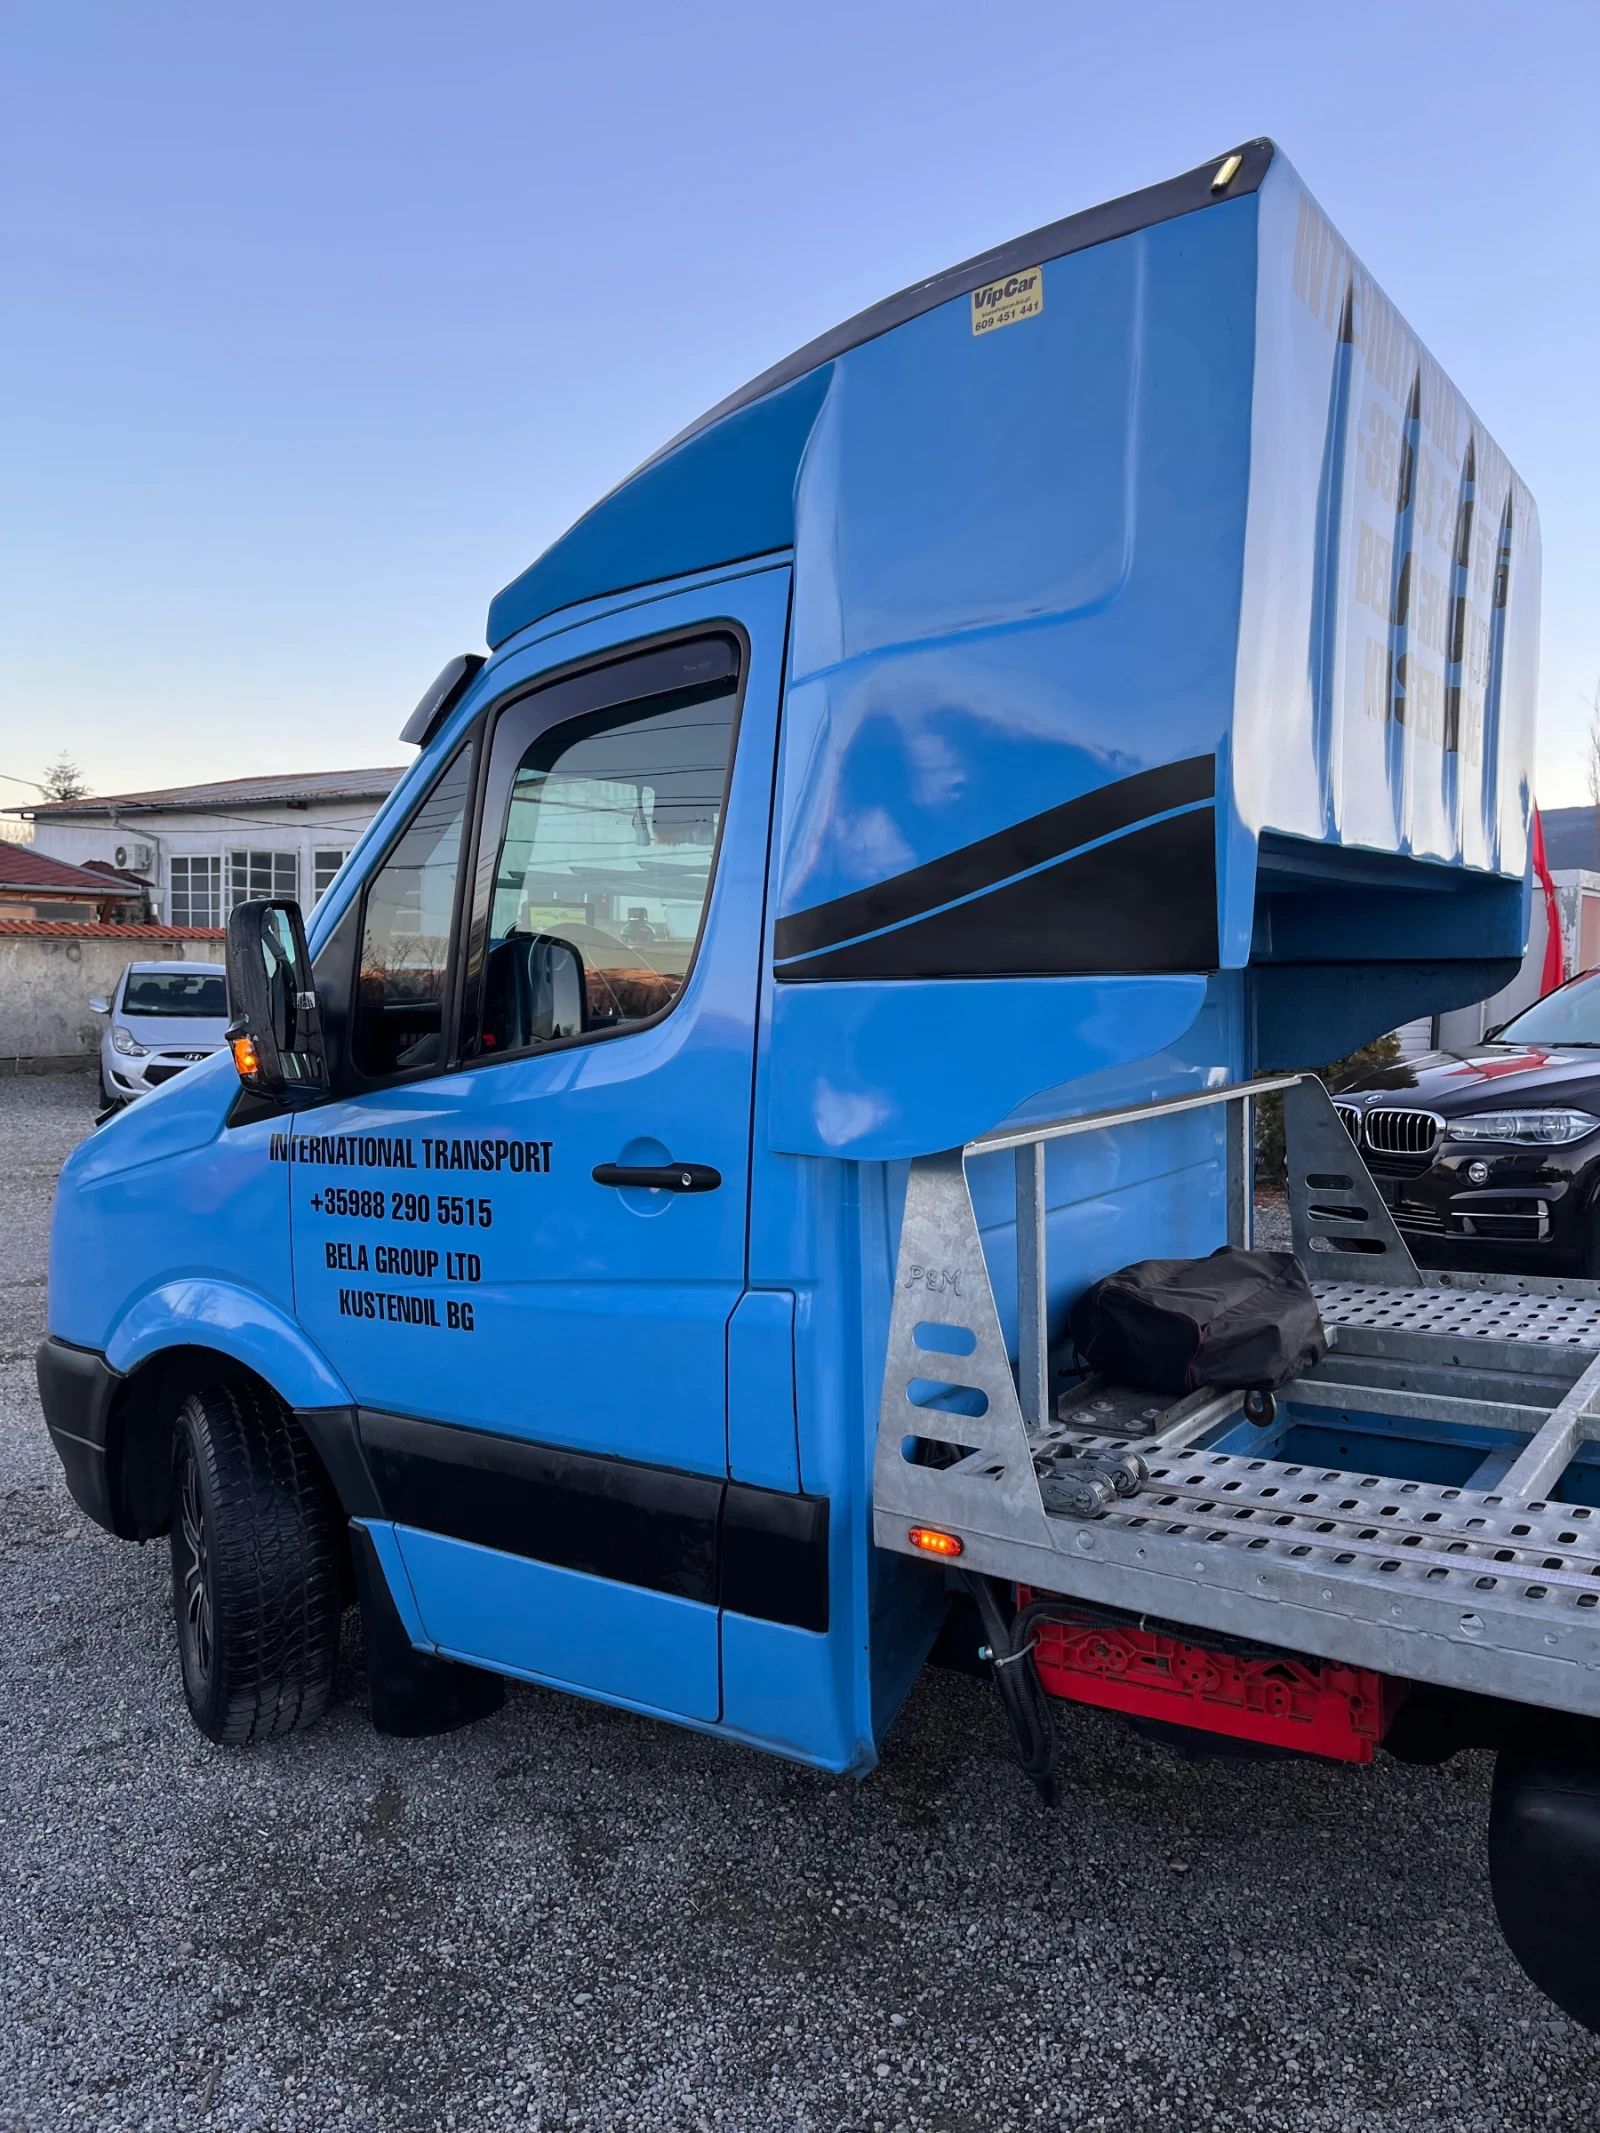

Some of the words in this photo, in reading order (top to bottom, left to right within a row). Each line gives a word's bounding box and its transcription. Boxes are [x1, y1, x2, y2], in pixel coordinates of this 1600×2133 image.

[974, 275, 1037, 309] VipCar
[975, 317, 994, 332] 609
[996, 309, 1016, 323] 451
[1019, 301, 1039, 315] 441
[269, 1133, 417, 1169] INTERNATIONAL
[421, 1138, 553, 1173] TRANSPORT
[310, 1187, 385, 1219] +35988
[391, 1192, 430, 1223] 290
[437, 1195, 492, 1228] 5515
[325, 1242, 369, 1272] BELA
[375, 1246, 439, 1278] GROUP
[446, 1252, 481, 1282] LTD
[904, 1264, 963, 1296] P&M
[339, 1288, 441, 1327] KUSTENDIL
[447, 1301, 475, 1332] BG
